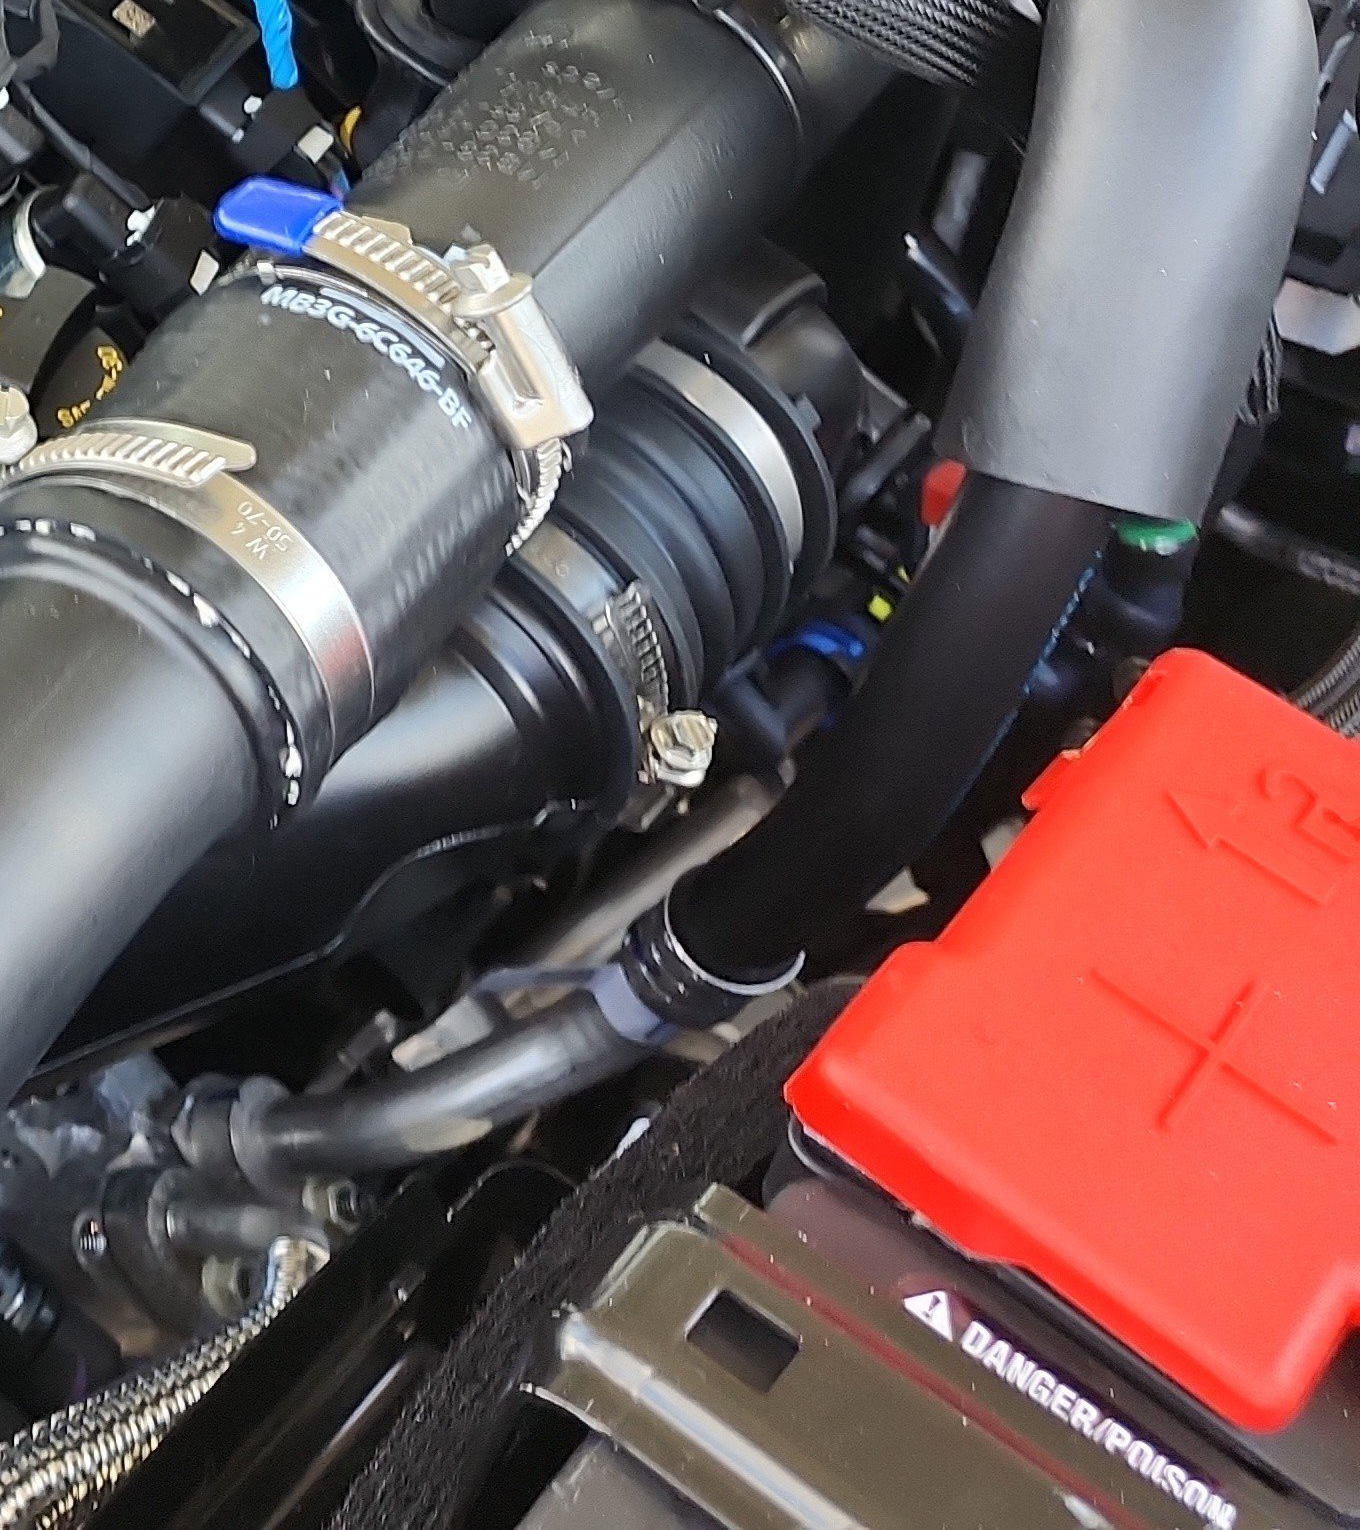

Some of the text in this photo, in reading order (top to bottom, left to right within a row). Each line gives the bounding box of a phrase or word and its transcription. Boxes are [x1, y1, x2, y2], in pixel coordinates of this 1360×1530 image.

[237, 501, 294, 552] 50-70
[245, 537, 270, 560] W
[959, 1319, 1239, 1529] DANGER/POISON
